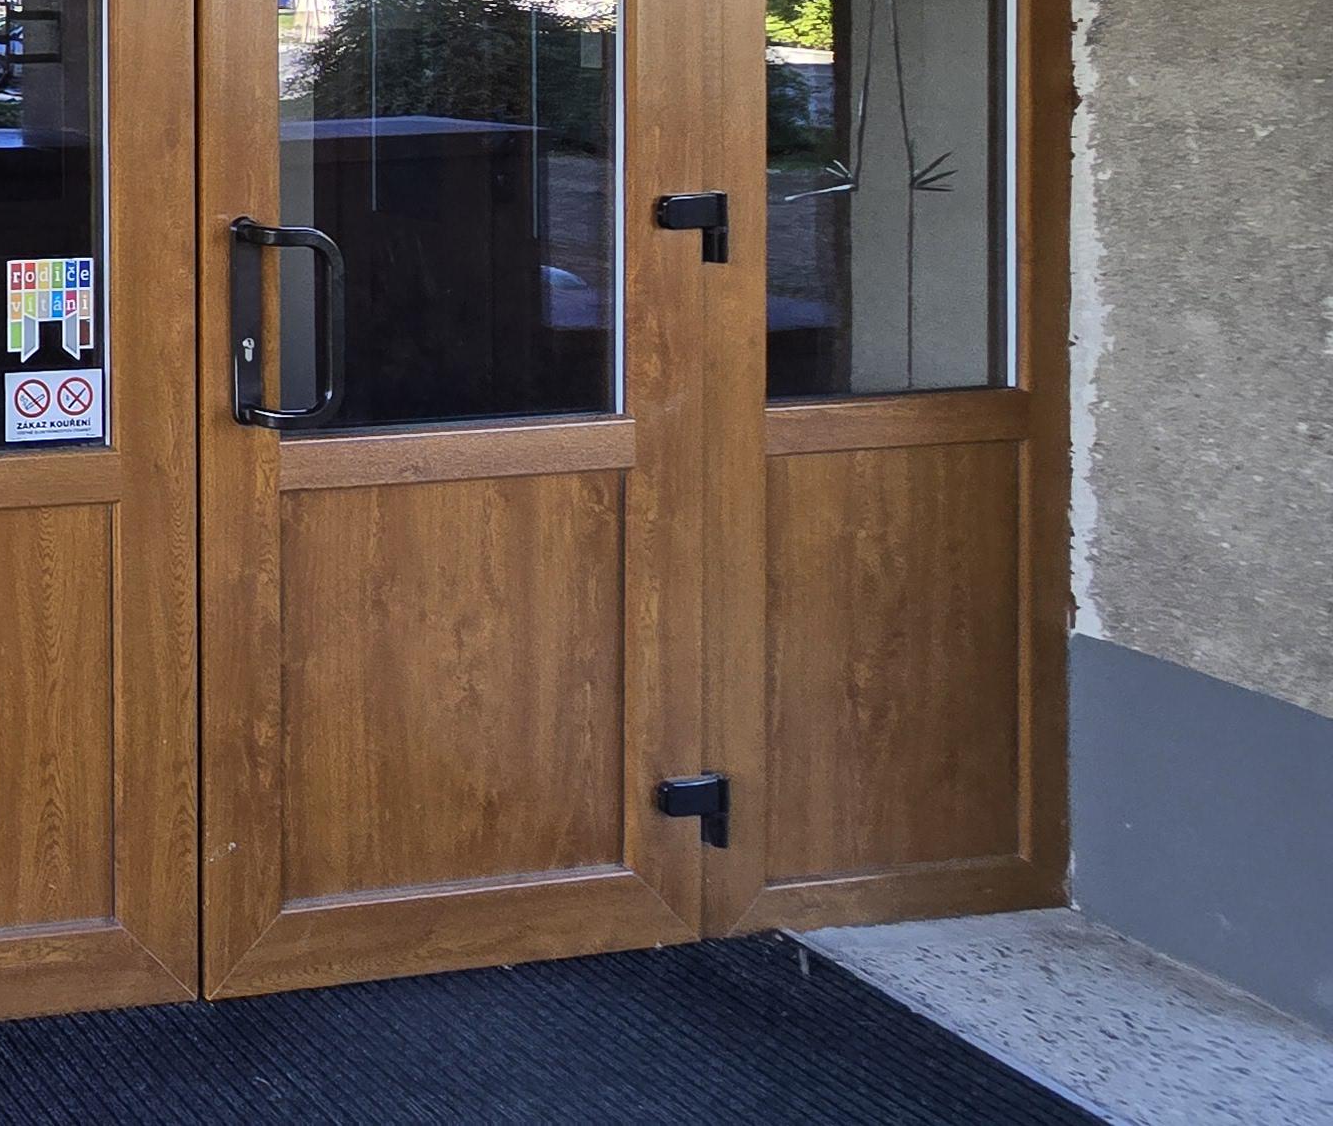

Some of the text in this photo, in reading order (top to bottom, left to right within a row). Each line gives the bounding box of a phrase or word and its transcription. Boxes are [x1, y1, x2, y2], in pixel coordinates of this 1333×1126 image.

[11, 264, 90, 283] rodiče
[11, 295, 88, 313] vítáni
[16, 417, 91, 430] ZÁKAZ KOUŘENÍ
